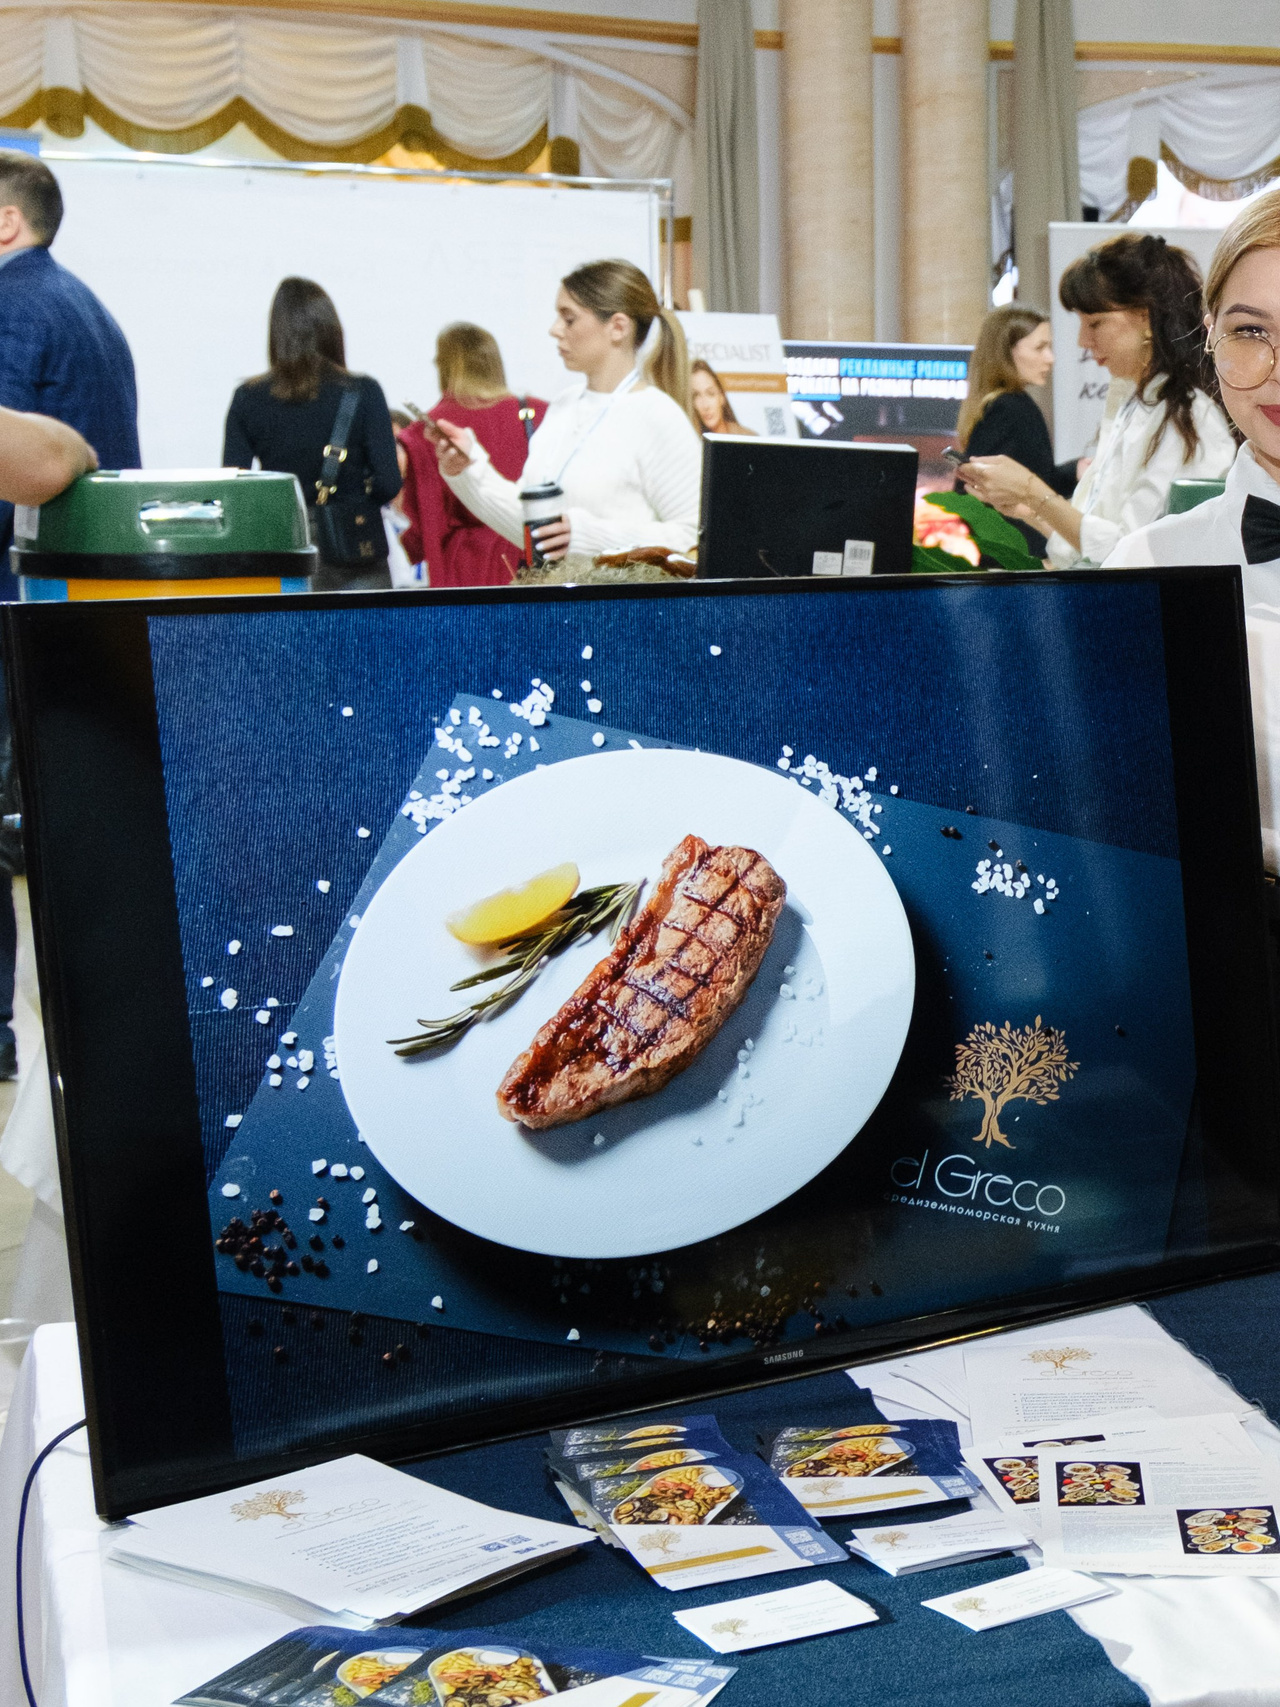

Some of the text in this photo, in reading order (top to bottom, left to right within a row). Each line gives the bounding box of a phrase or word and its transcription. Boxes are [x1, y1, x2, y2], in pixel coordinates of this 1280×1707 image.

[917, 360, 967, 380] РОЛИКИ
[891, 1149, 1067, 1216] el Greco
[1026, 1220, 1061, 1234] кухня
[763, 1349, 804, 1366] SAMSUNG
